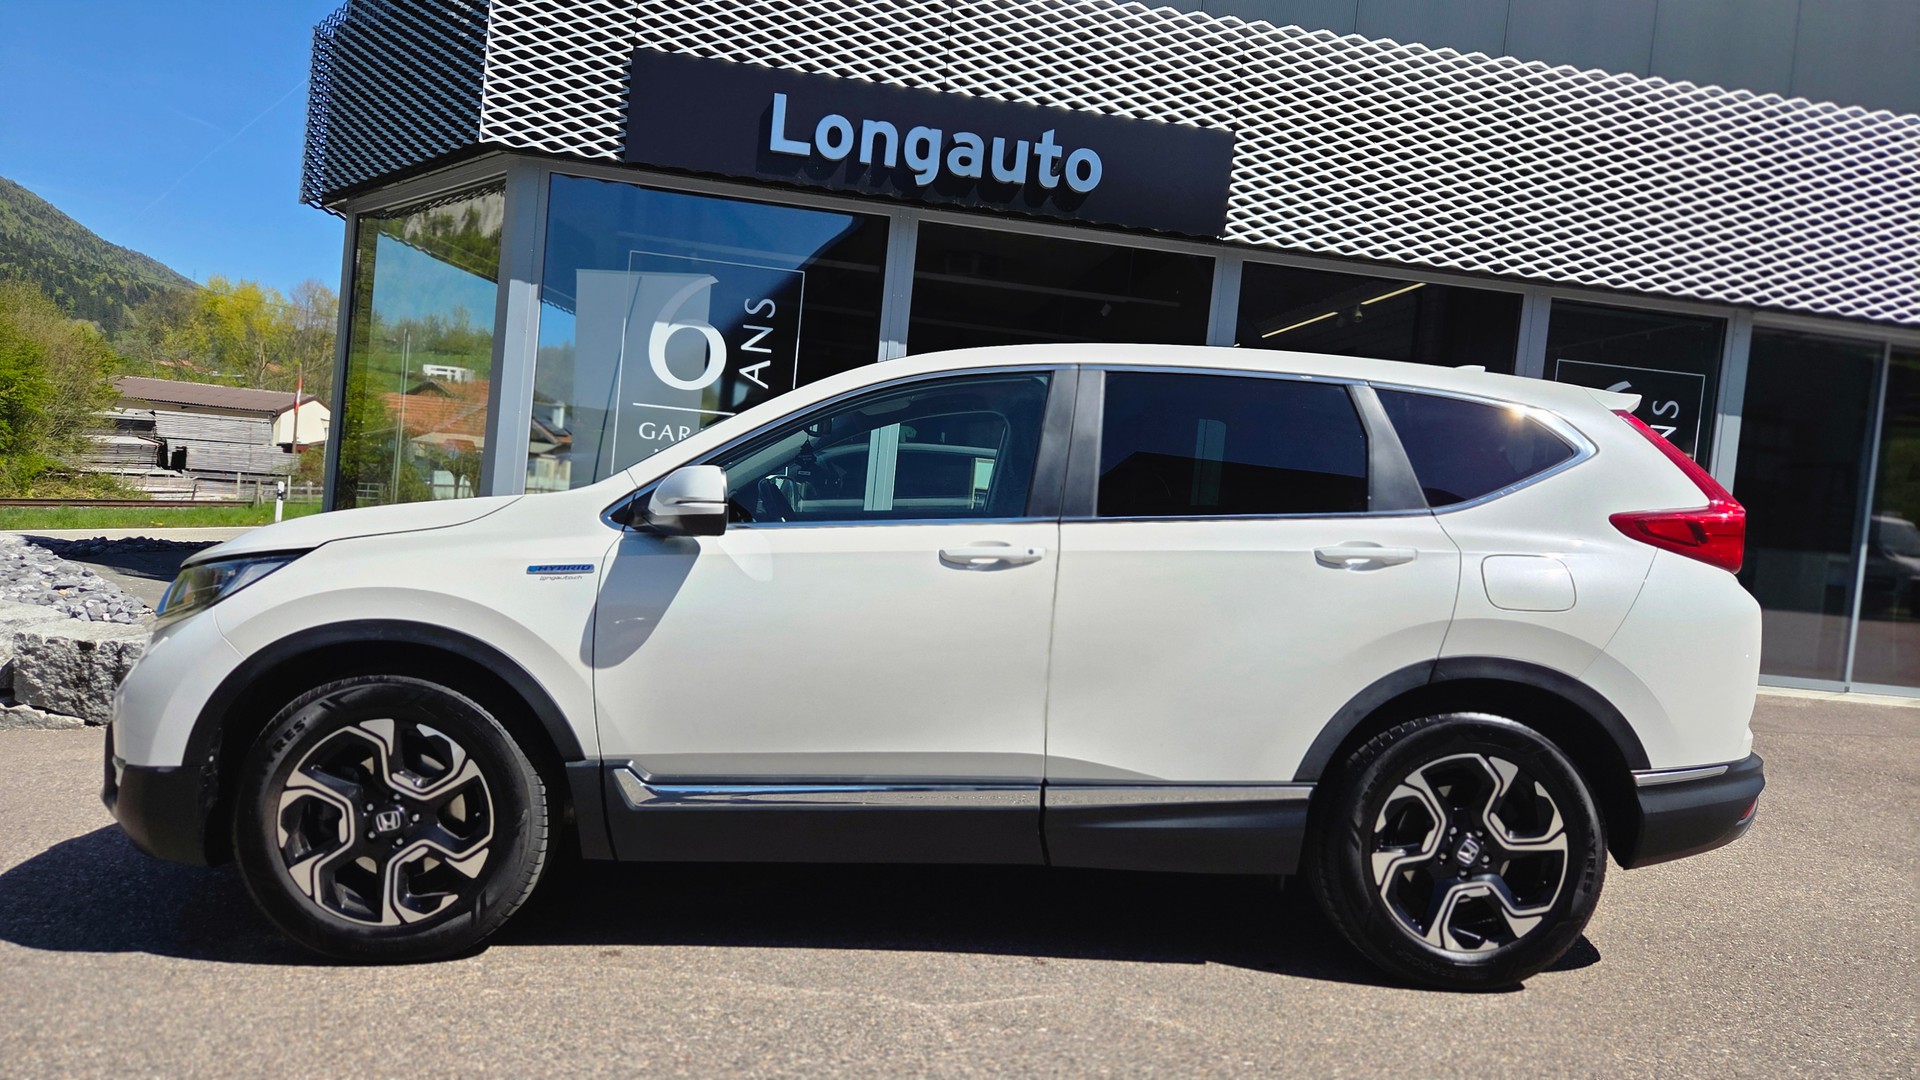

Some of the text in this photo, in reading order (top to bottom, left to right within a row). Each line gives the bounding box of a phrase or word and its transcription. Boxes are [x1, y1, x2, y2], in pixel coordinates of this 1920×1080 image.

[769, 92, 1103, 193] Longauto
[648, 274, 727, 391] 6
[738, 298, 776, 390] ANS
[638, 421, 692, 442] GAR
[540, 564, 592, 572] HYBRID
